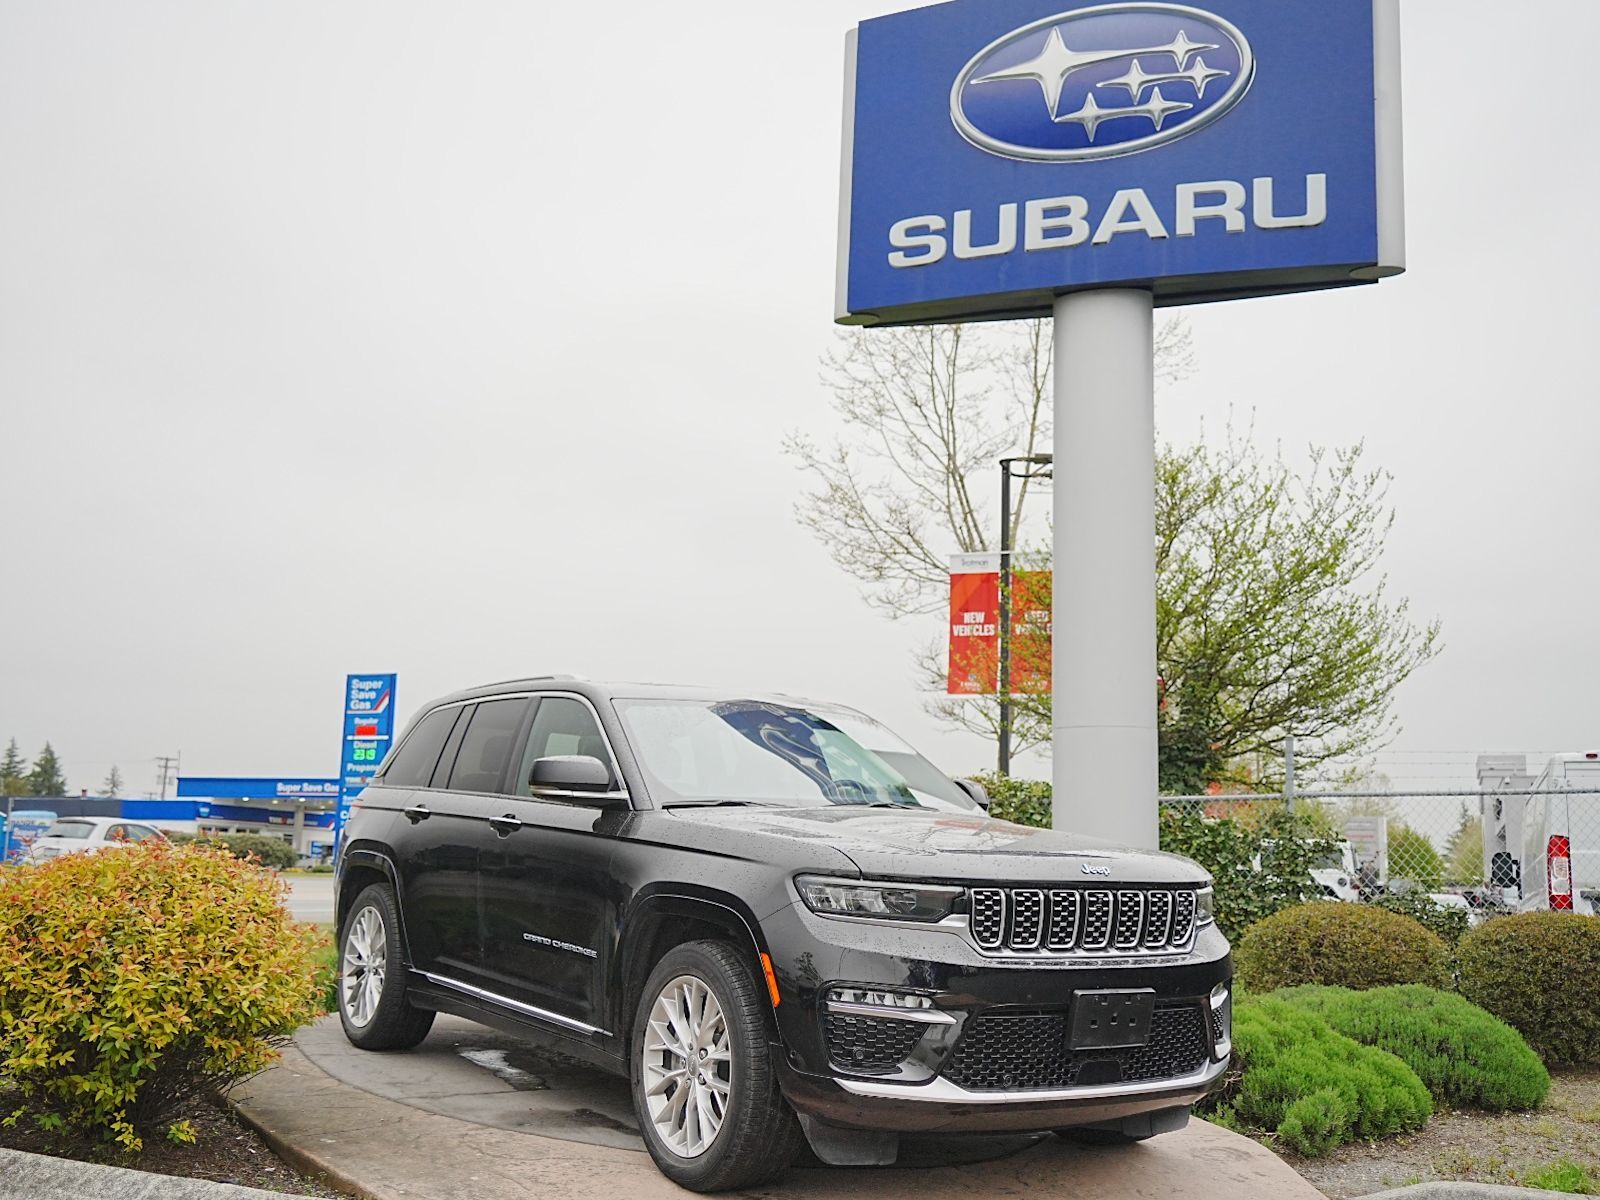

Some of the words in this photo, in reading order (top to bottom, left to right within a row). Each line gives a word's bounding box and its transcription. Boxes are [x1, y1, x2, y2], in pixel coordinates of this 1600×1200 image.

[887, 172, 1327, 268] SUBARU
[963, 612, 985, 624] NEW
[953, 624, 995, 636] VEHICLES
[351, 679, 383, 691] Super
[351, 689, 377, 700] Save
[350, 699, 371, 710] Gas
[276, 782, 301, 793] Super
[302, 782, 323, 792] Save
[323, 782, 339, 792] Gas
[1080, 863, 1111, 877] Jeep
[522, 932, 552, 946] GRAND
[552, 940, 598, 959] CHEROKEE
